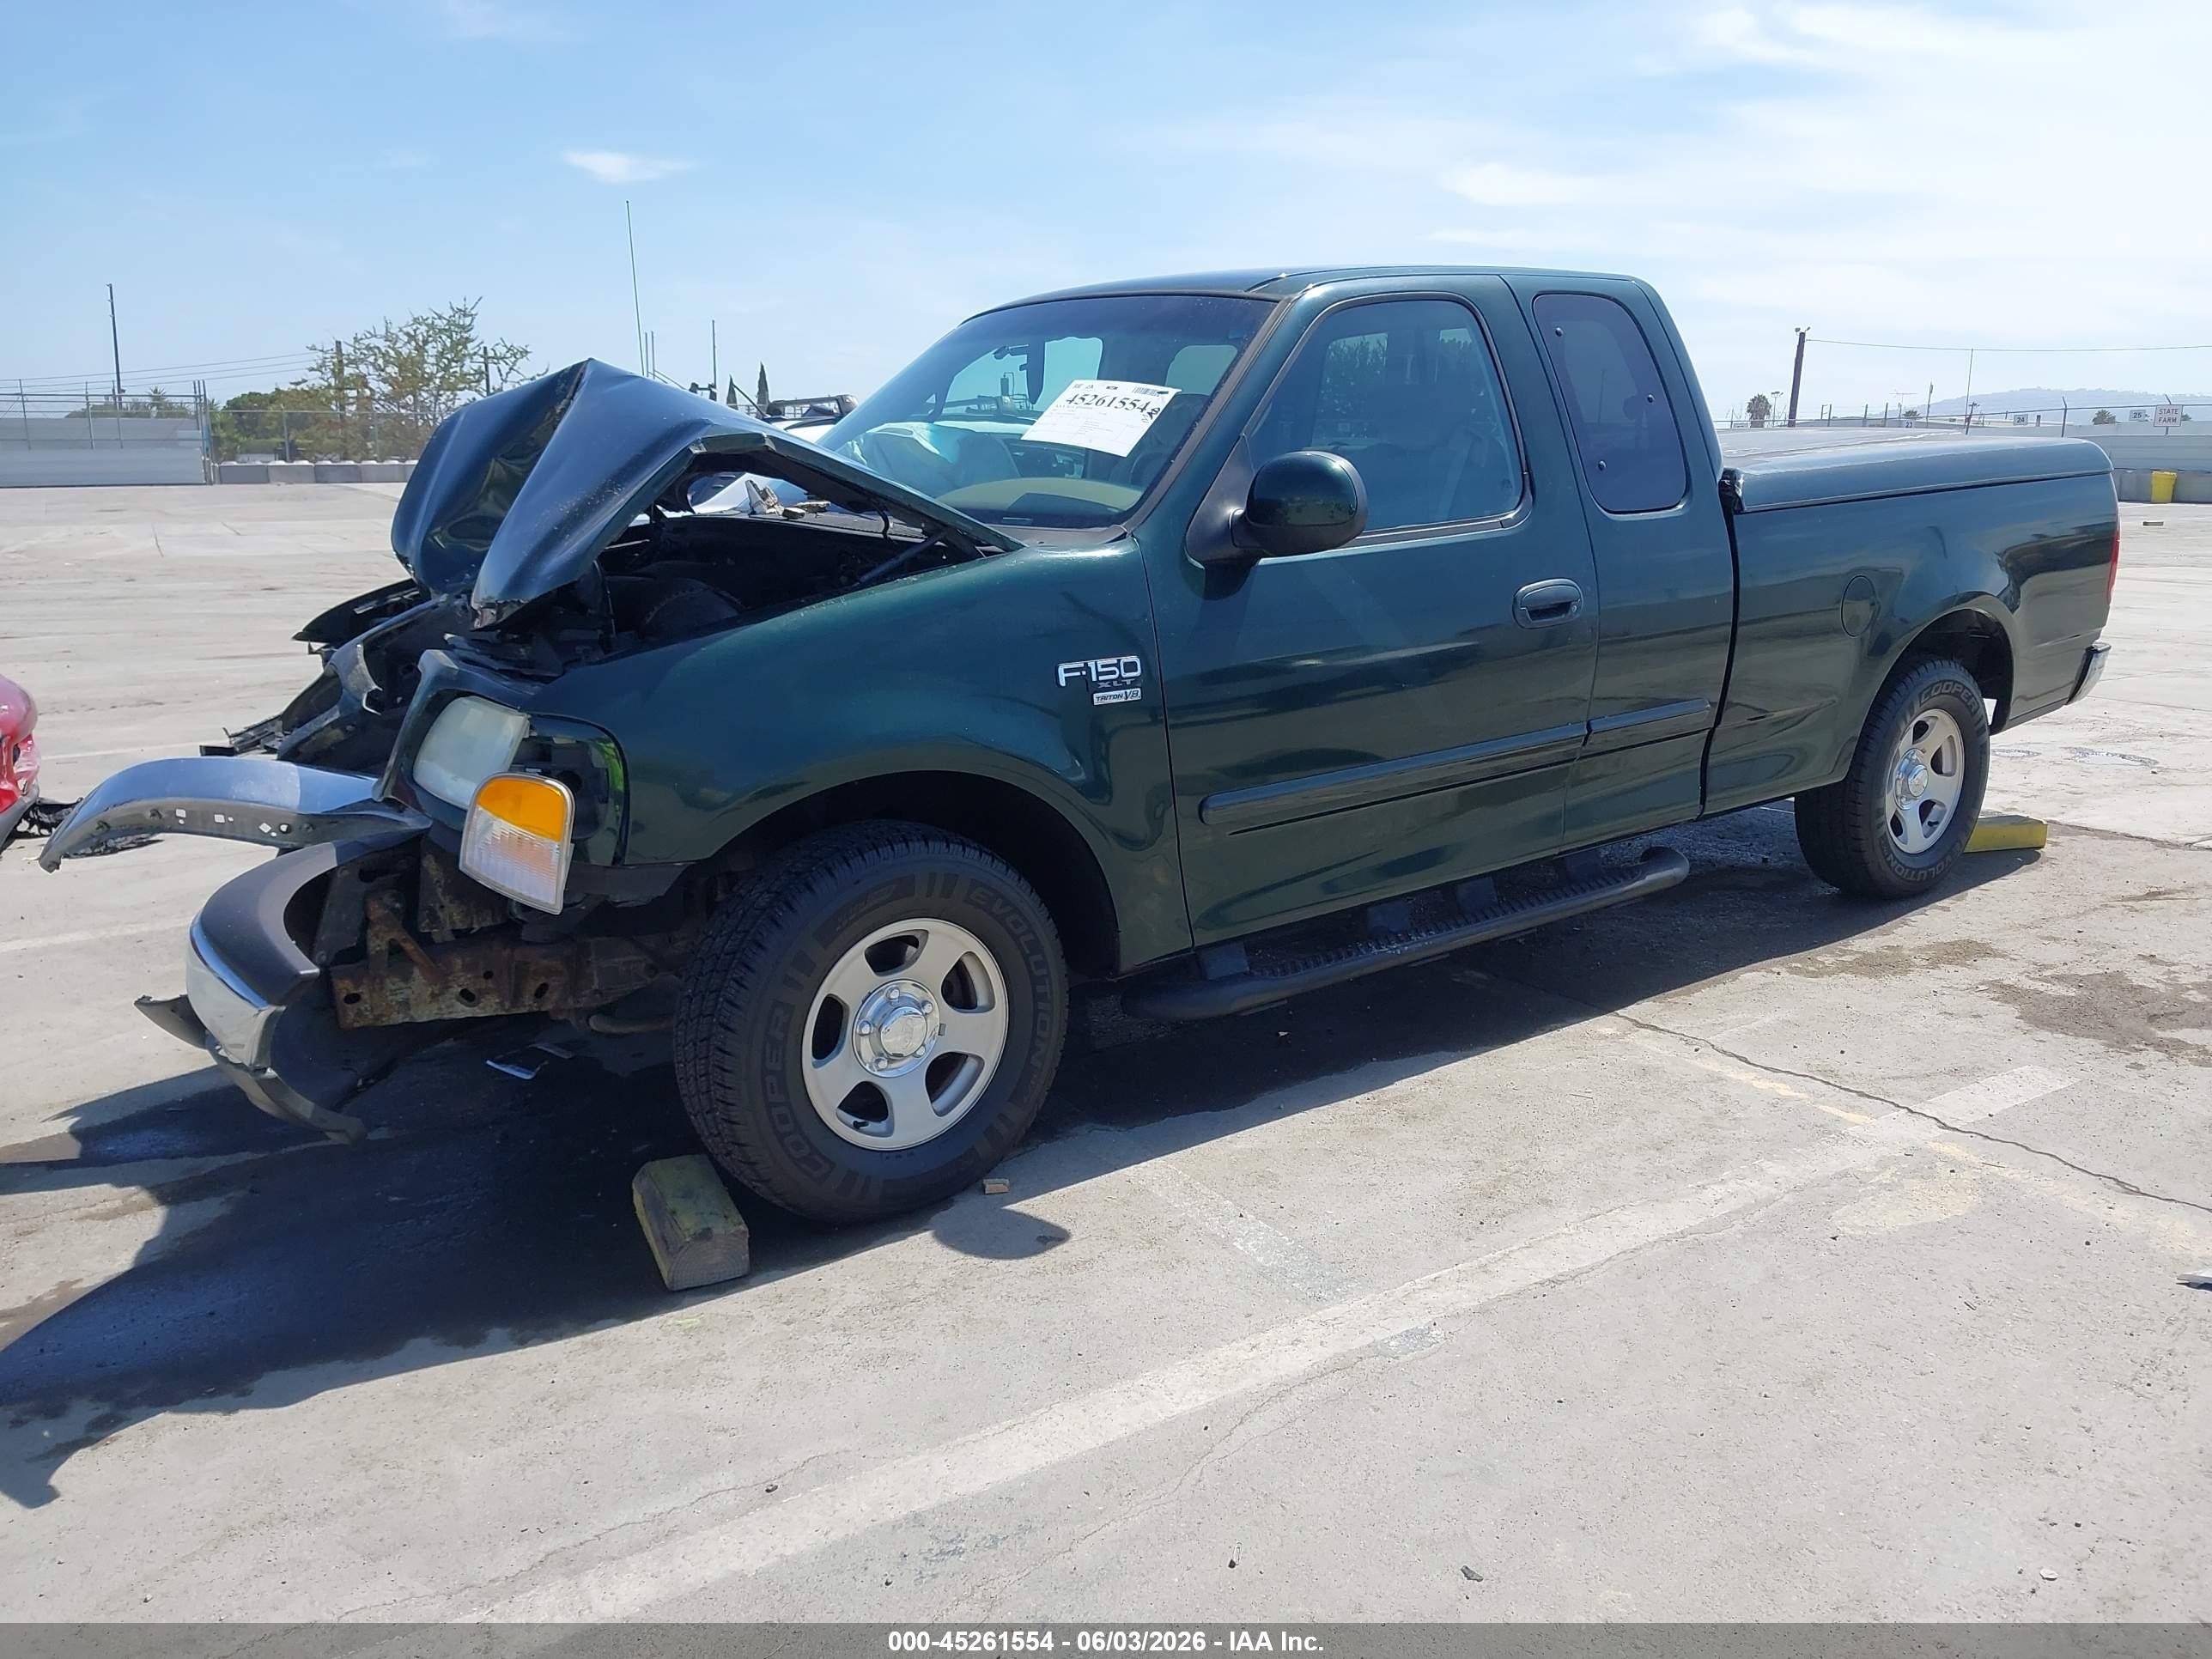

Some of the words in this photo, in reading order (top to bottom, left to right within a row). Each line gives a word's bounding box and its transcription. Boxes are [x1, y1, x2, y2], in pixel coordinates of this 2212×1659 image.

[1066, 393, 1152, 413] 45261554
[1095, 692, 1124, 702] TRITON
[1123, 690, 1139, 701] V8
[1097, 678, 1136, 689] XLT
[1921, 681, 1978, 714] COOPER
[969, 884, 1054, 1073] EVOLUTION
[764, 1005, 833, 1180] COOPER
